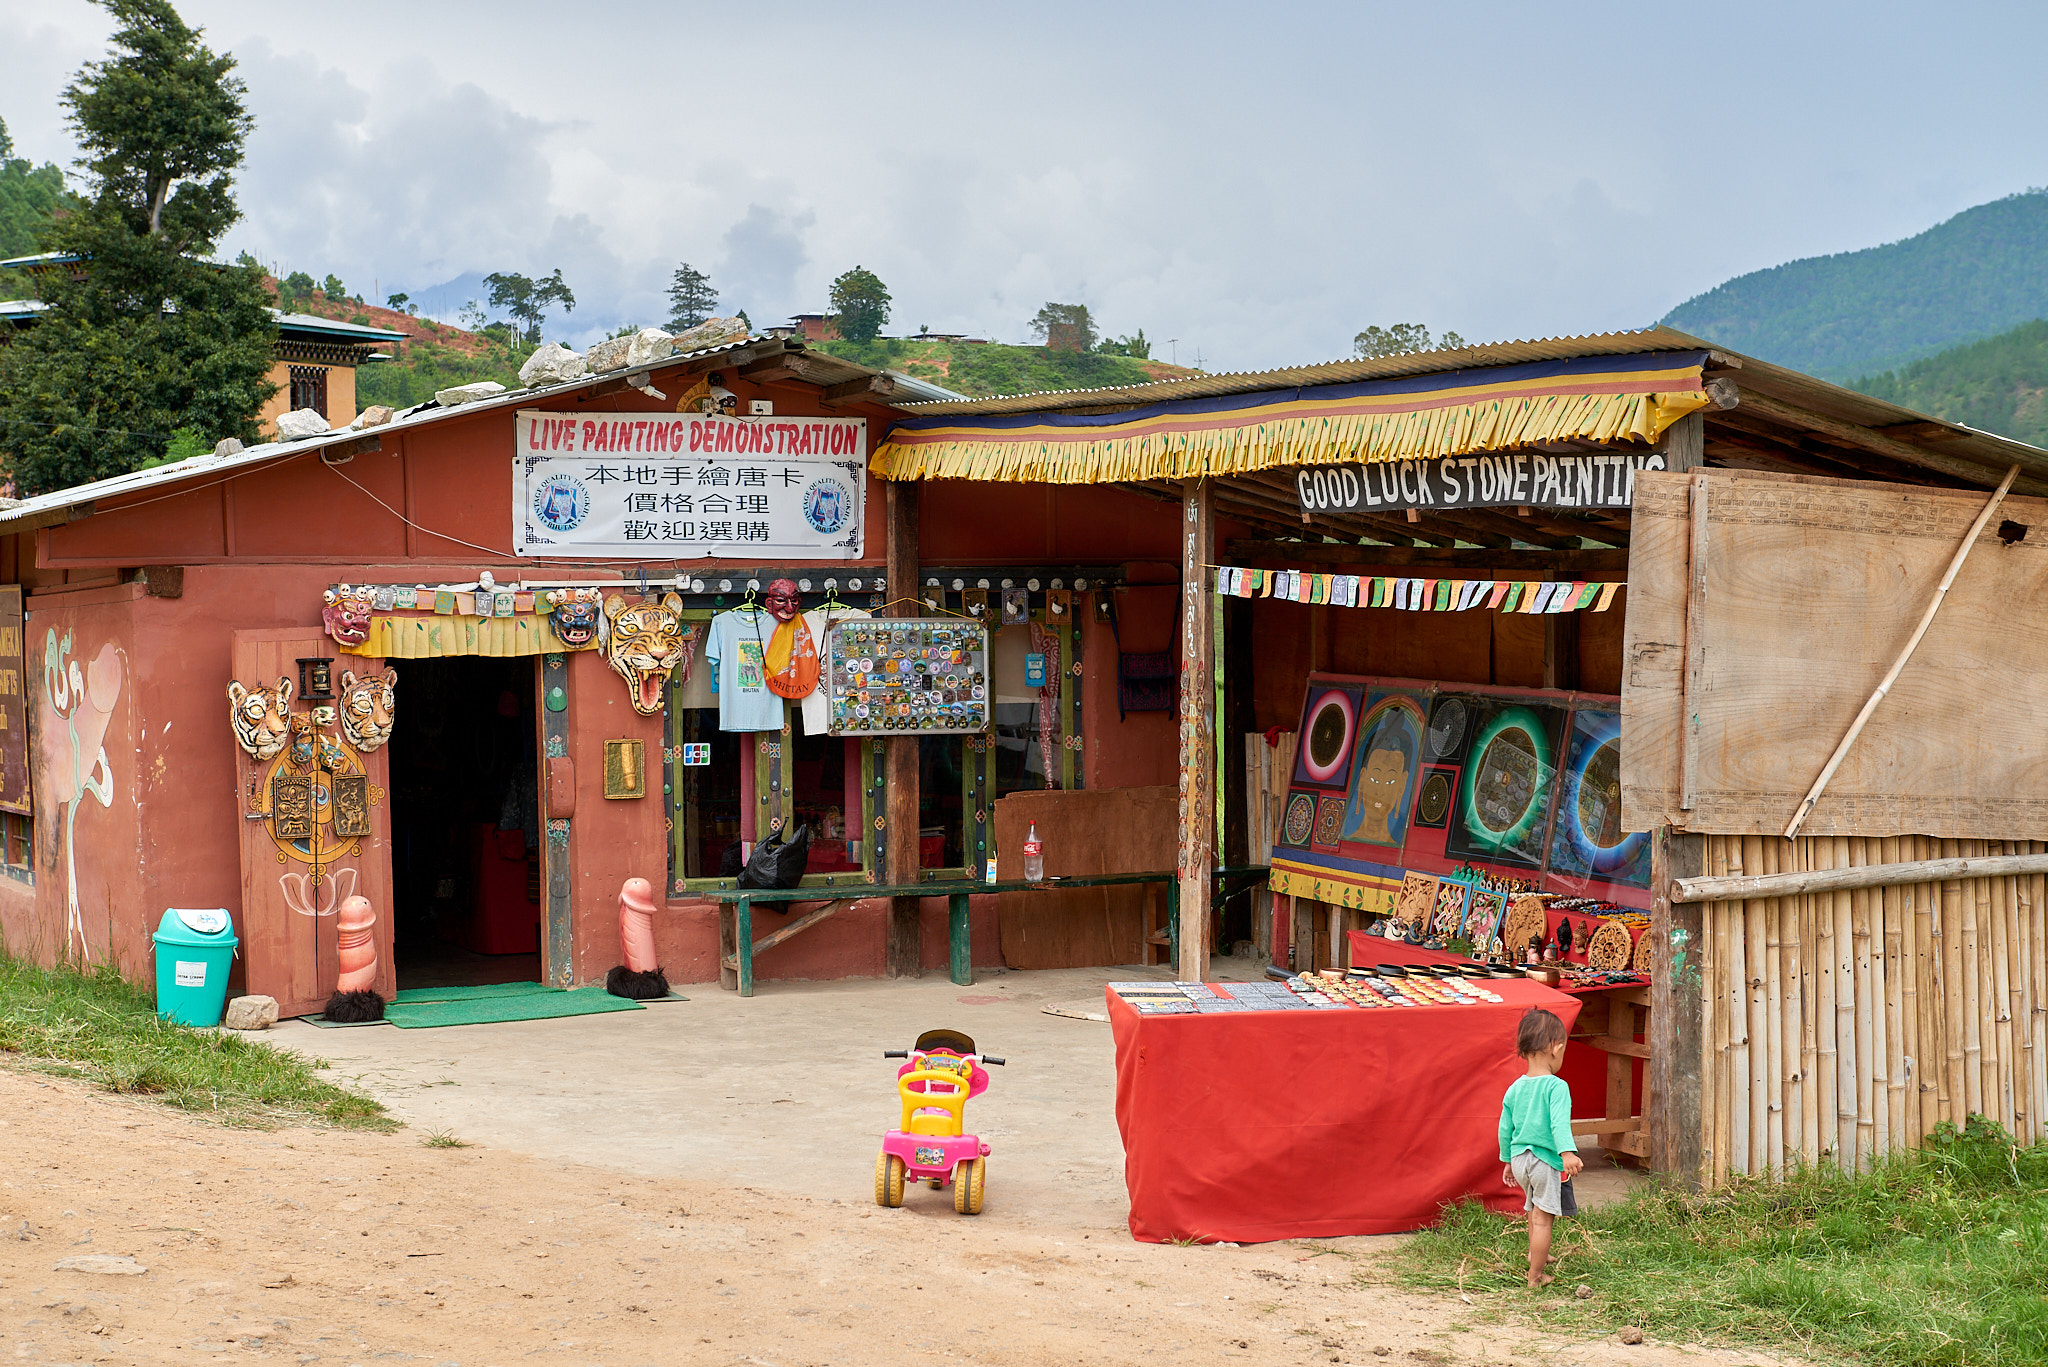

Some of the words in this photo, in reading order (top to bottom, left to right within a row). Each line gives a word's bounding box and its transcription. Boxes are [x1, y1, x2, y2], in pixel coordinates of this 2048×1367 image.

[529, 419, 577, 451] LIVE
[582, 420, 683, 452] PAINTING
[689, 420, 858, 456] DEMONSTRATION
[541, 474, 571, 488] QUALITY
[585, 464, 804, 488] 本地手繪唐卡
[809, 477, 836, 490] QUALITY
[1298, 468, 1359, 509] GOOD
[1361, 460, 1434, 505] LUCK
[1440, 455, 1528, 504] STONE
[623, 492, 770, 514] 價格合理
[547, 521, 577, 531] BHUTAN
[623, 520, 770, 541] 歡迎選購
[815, 523, 841, 533] BHUTAN
[773, 678, 809, 694] BHUTAN
[685, 750, 708, 758] JCB
